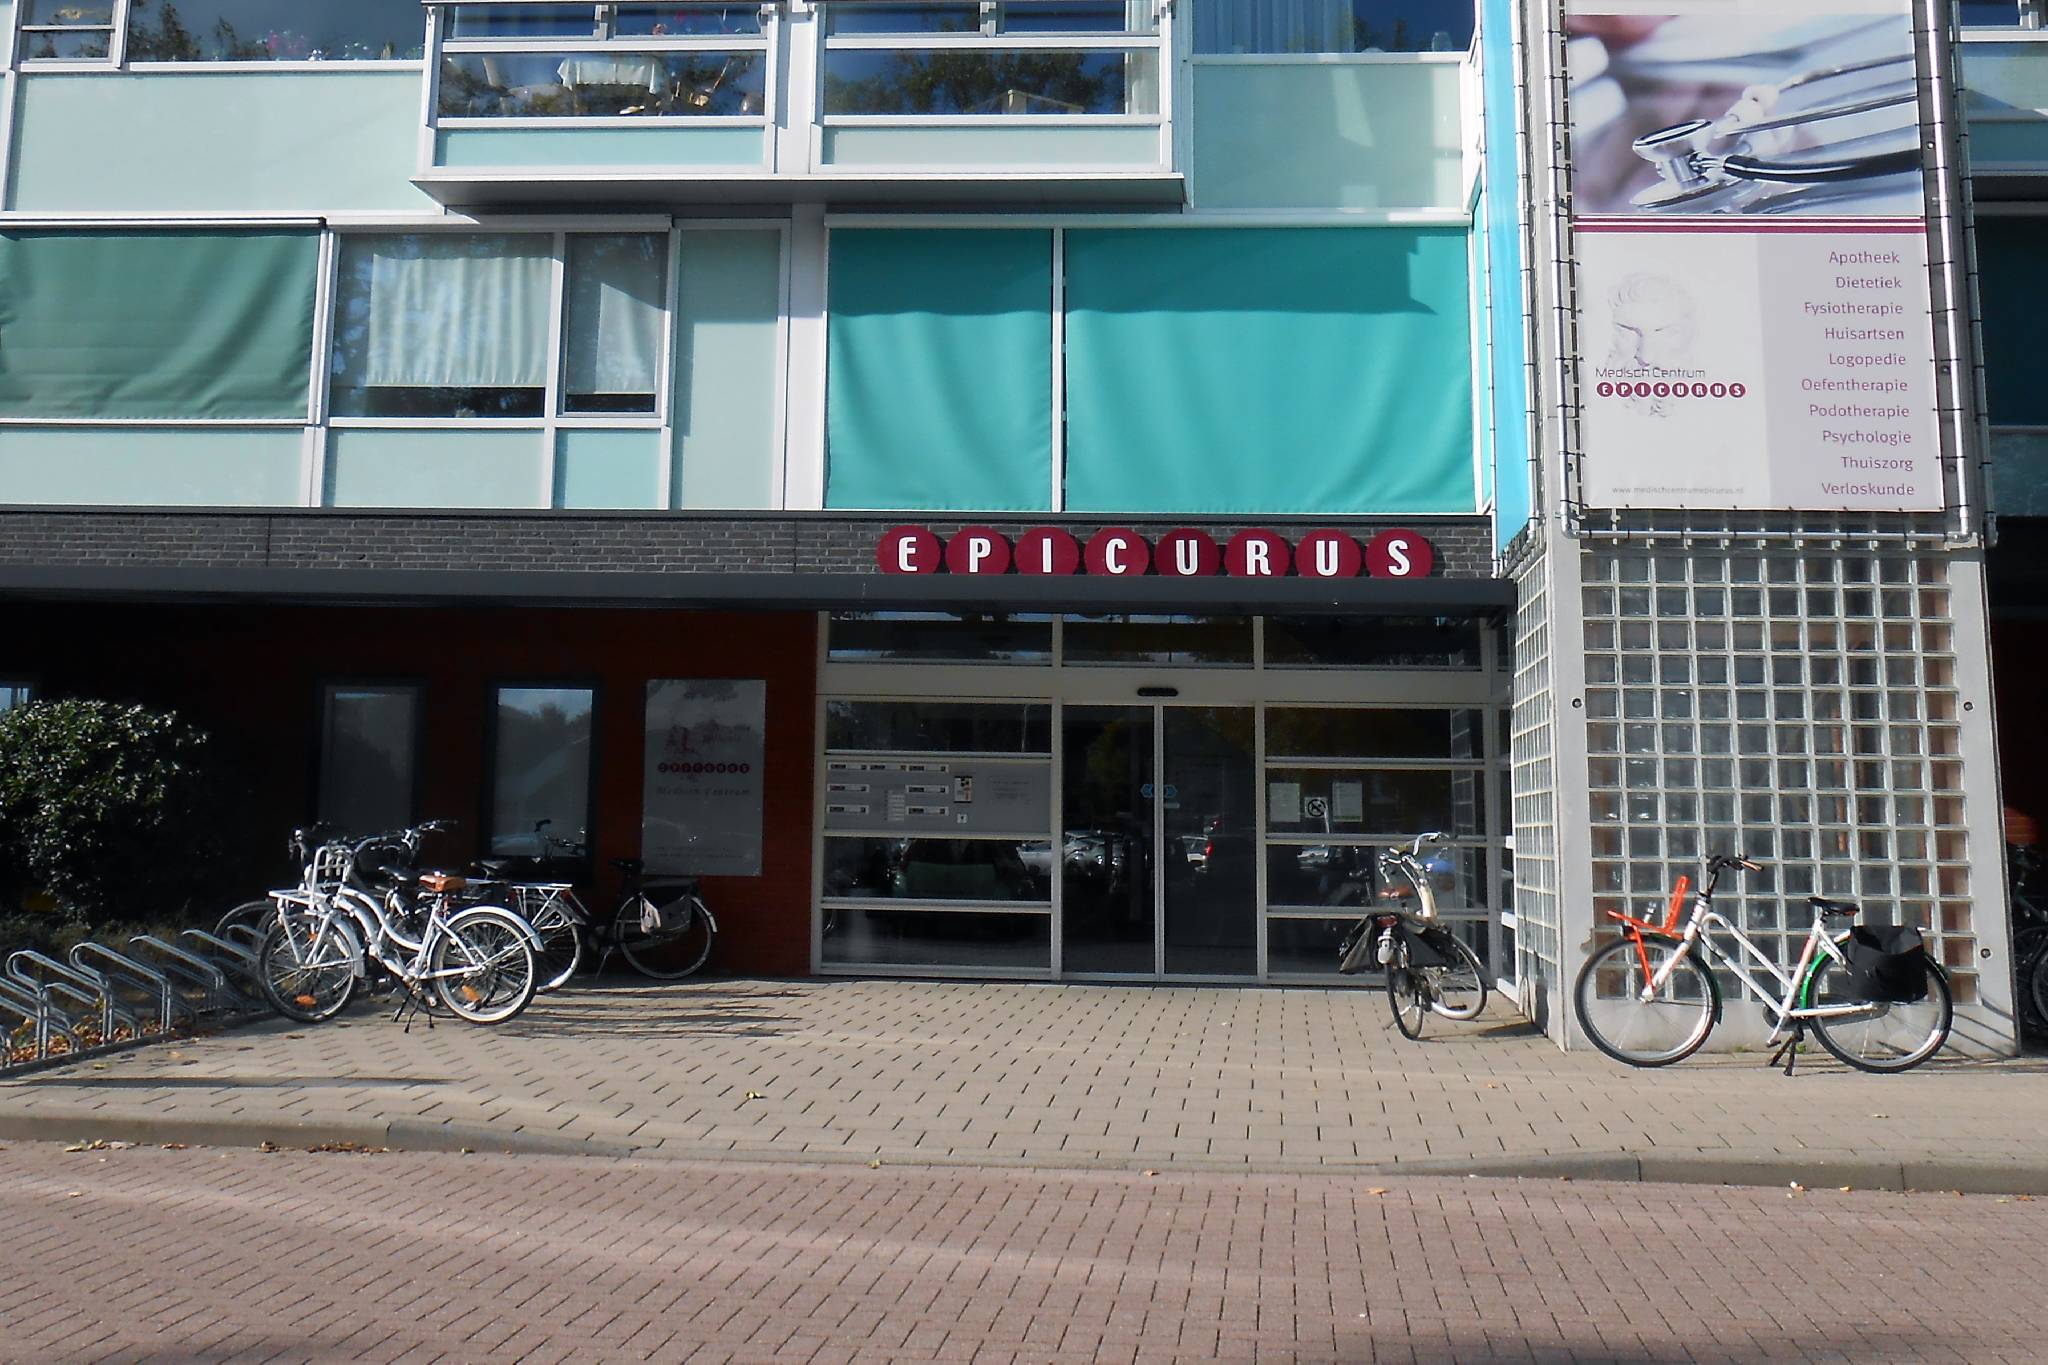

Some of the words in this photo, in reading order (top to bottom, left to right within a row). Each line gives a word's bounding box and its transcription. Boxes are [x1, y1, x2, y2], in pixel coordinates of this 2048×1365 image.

[1828, 251, 1900, 265] Apotheek
[1835, 276, 1902, 288] Dietetiek
[1804, 302, 1904, 316] Fysiotherapie
[1825, 328, 1905, 340] Huisartsen
[1829, 352, 1907, 366] Logopedie
[1595, 367, 1650, 378] Medisch
[1653, 367, 1706, 378] Centrum
[1598, 383, 1745, 398] EPICURUS
[1801, 378, 1908, 393] Oefentherapie
[1809, 404, 1910, 419] Podotherapie
[1822, 430, 1912, 446] Psychologie
[1841, 456, 1914, 471] Thuiszorg
[1821, 483, 1915, 496] Verloskunde
[896, 535, 1412, 578] EPICURUS
